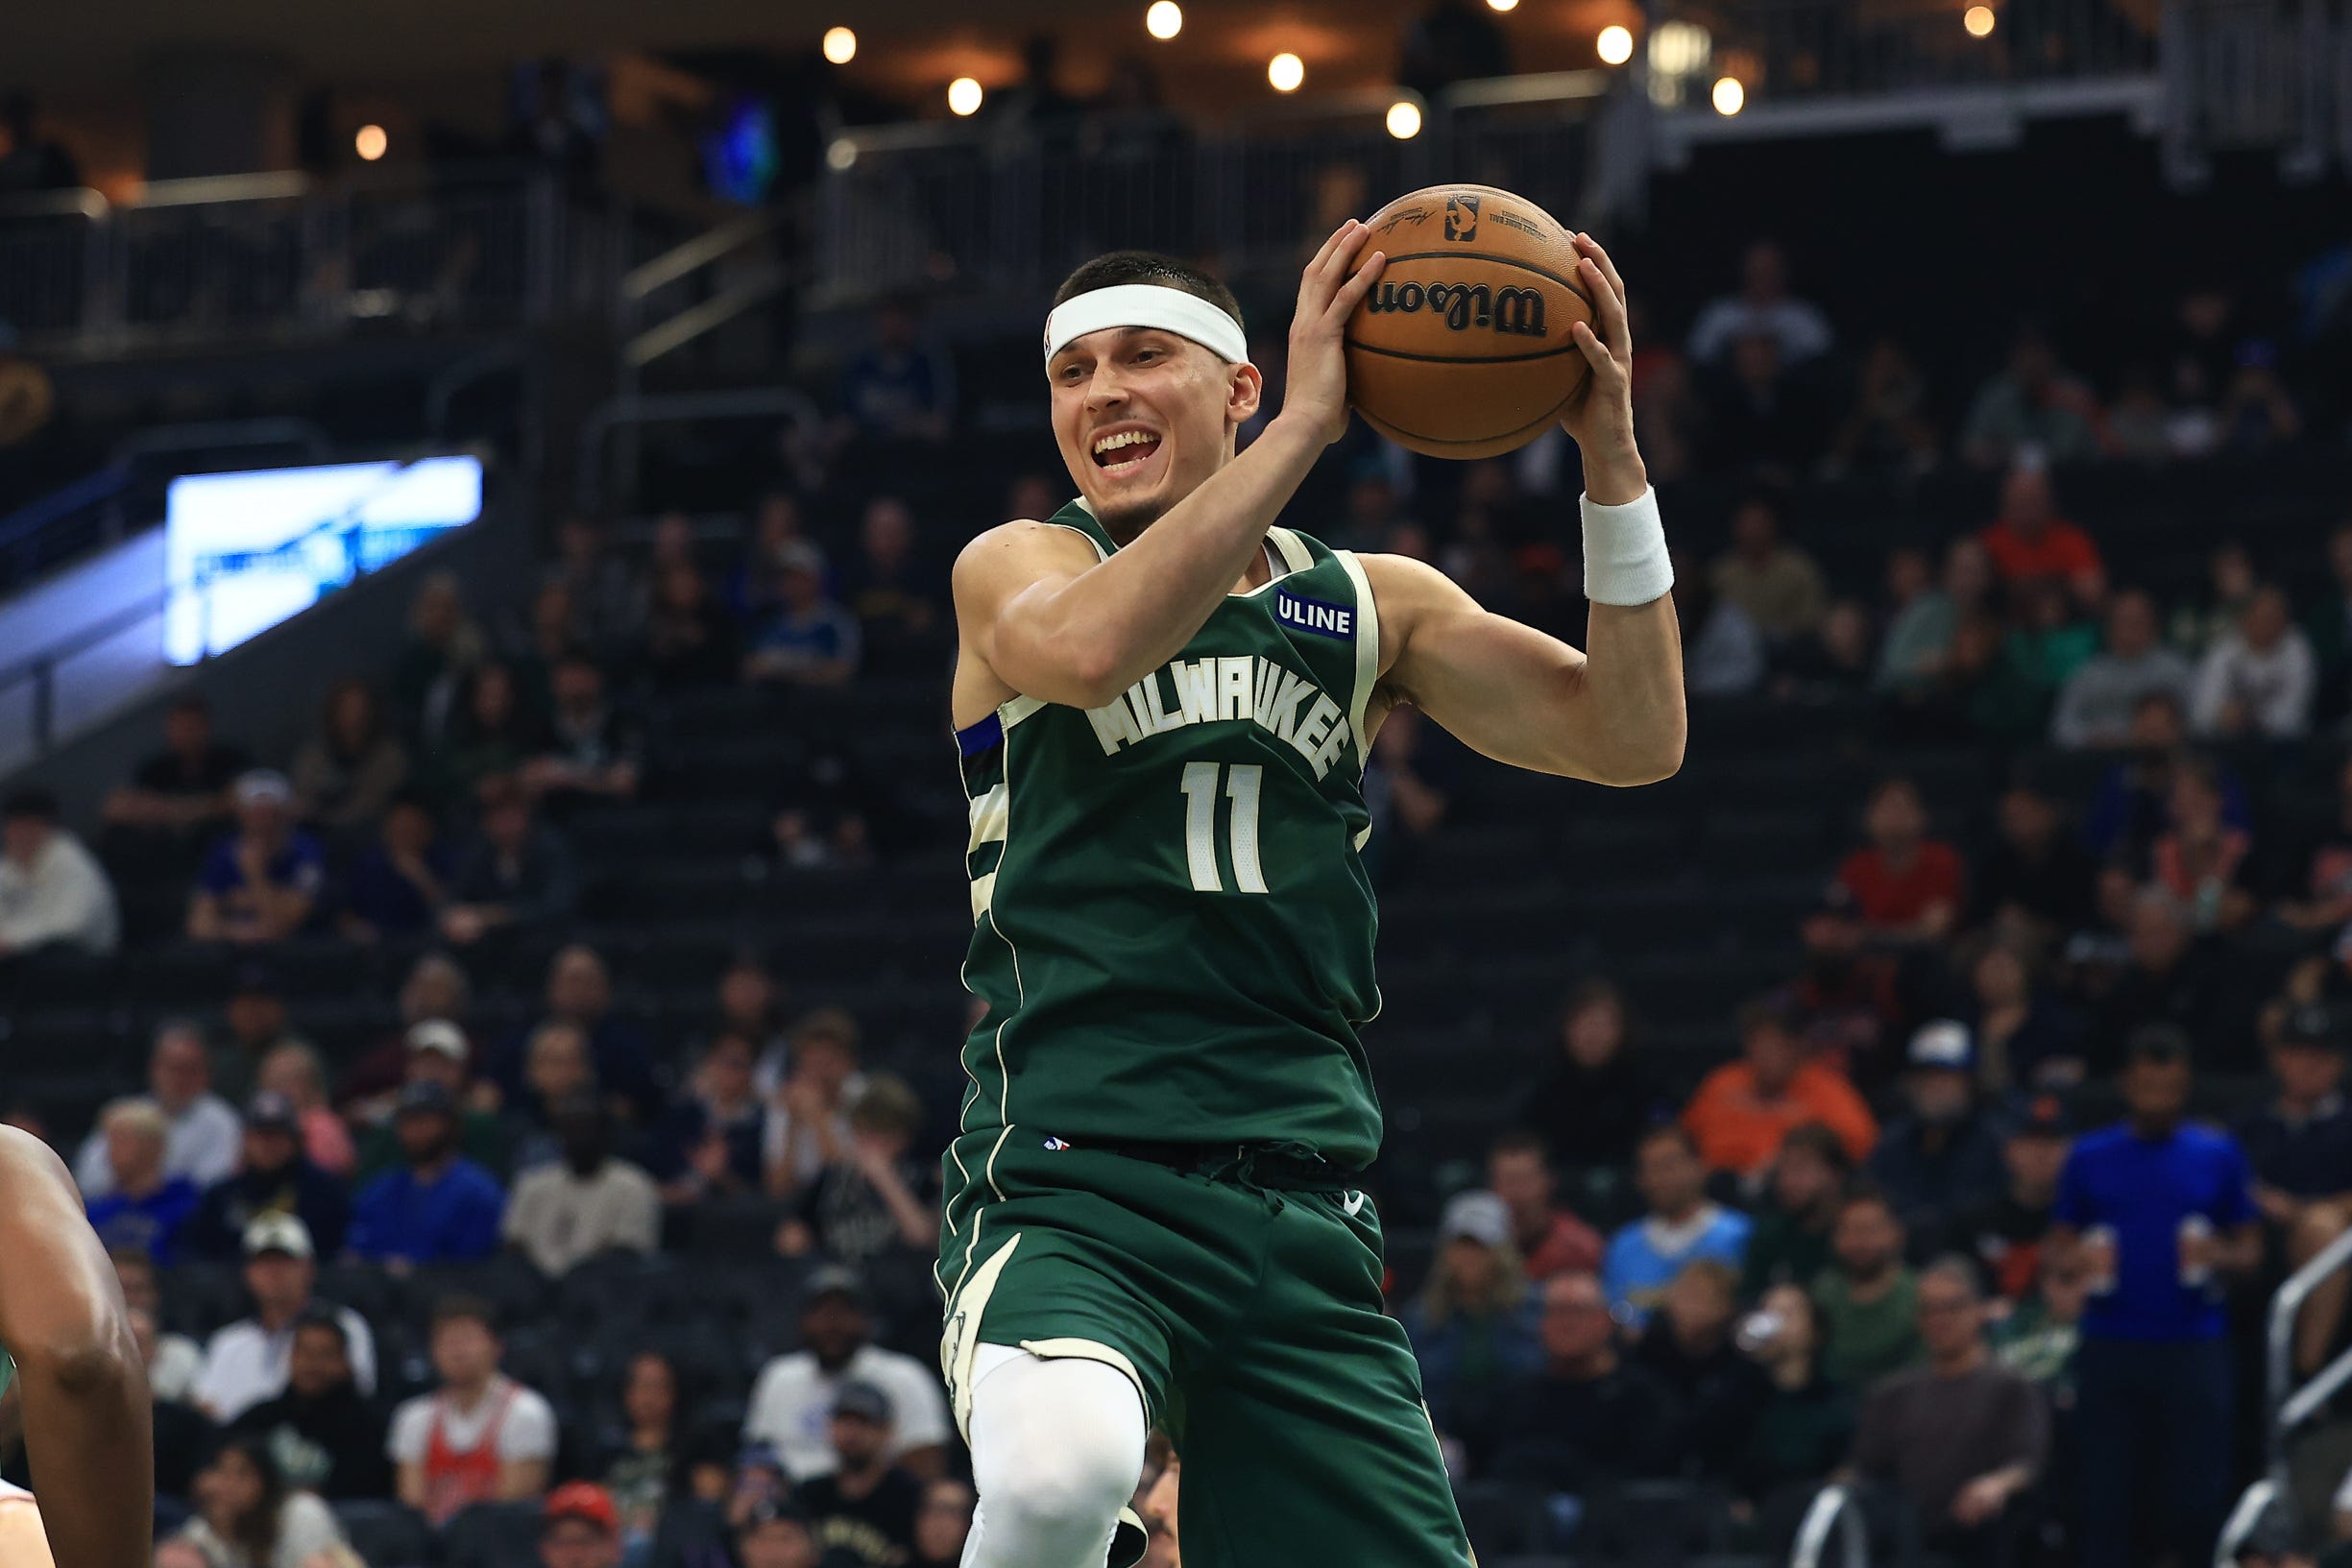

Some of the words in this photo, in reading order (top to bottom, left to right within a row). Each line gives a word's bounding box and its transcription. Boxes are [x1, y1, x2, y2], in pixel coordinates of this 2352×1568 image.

[1368, 281, 1548, 338] Wilson
[1278, 594, 1350, 635] ULINE
[1180, 761, 1270, 894] 11
